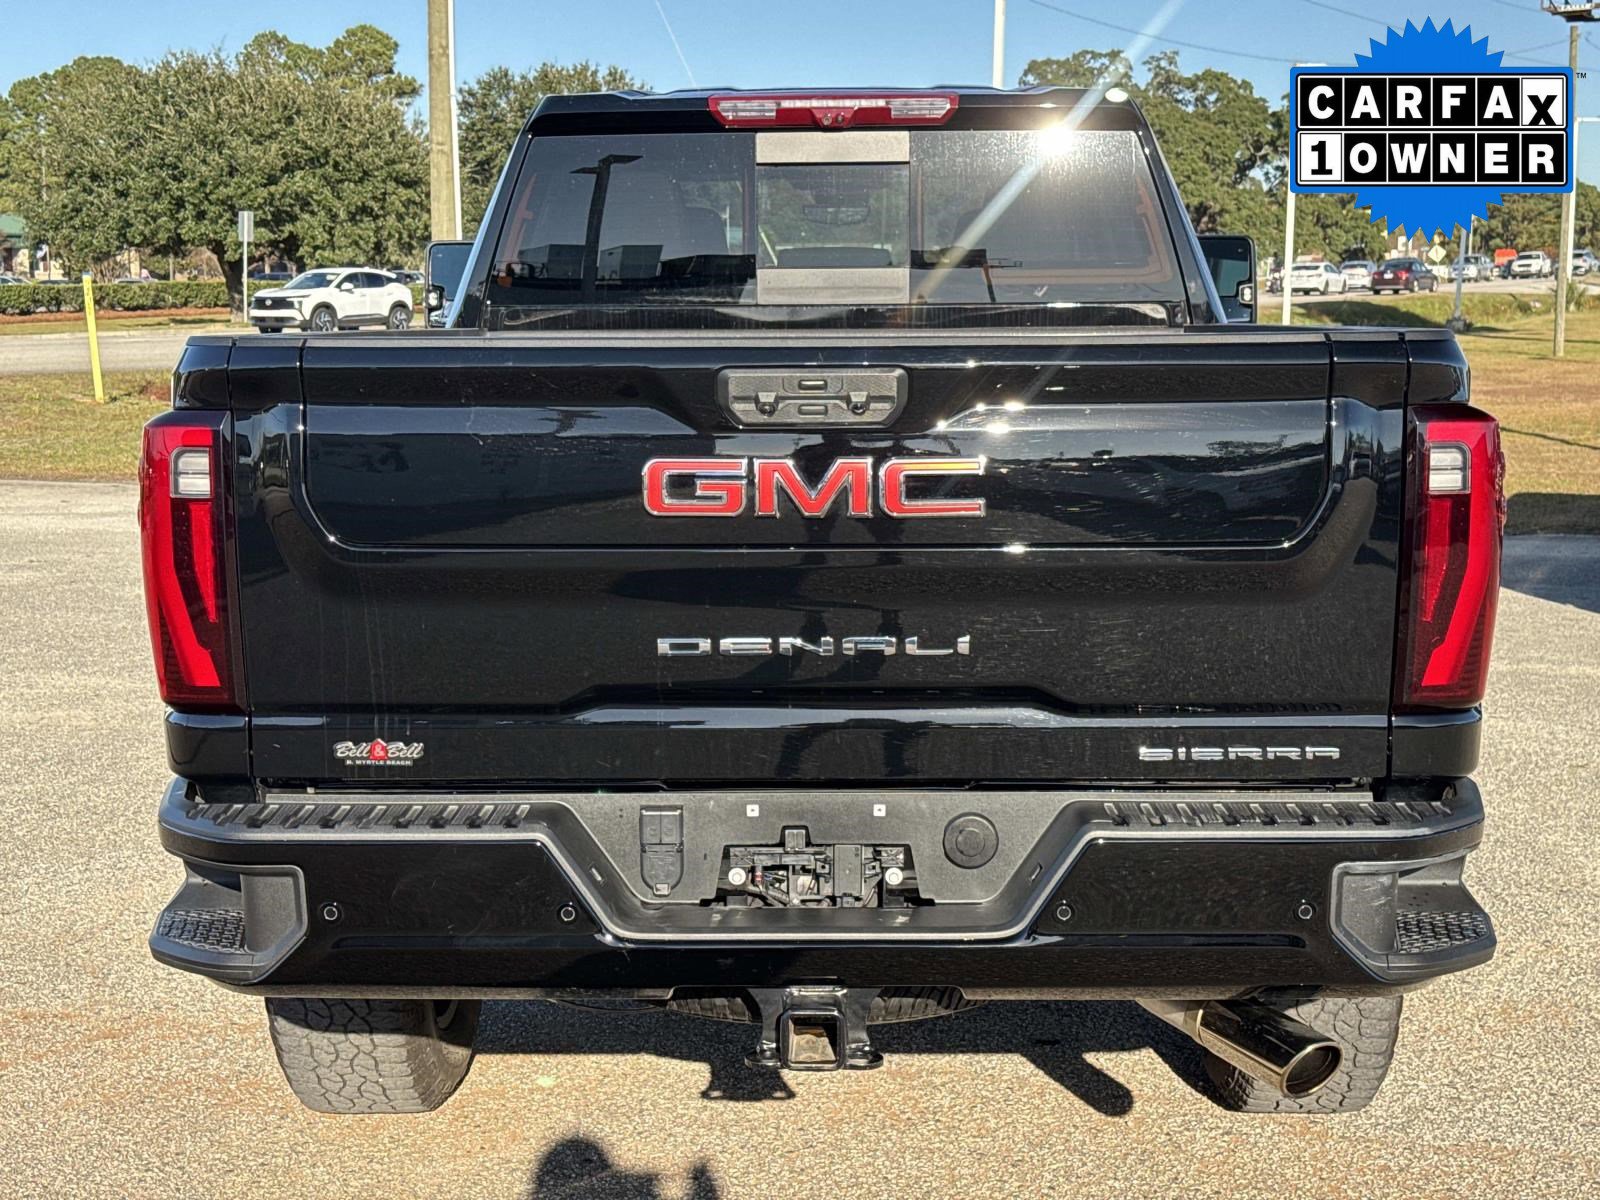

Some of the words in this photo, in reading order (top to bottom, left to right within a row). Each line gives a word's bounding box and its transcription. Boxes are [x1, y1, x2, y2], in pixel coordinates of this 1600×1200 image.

[642, 454, 987, 519] GMC
[657, 635, 971, 656] DENALI
[334, 741, 372, 758] Bell
[386, 741, 424, 758] Bell
[1138, 746, 1340, 761] SIERRA
